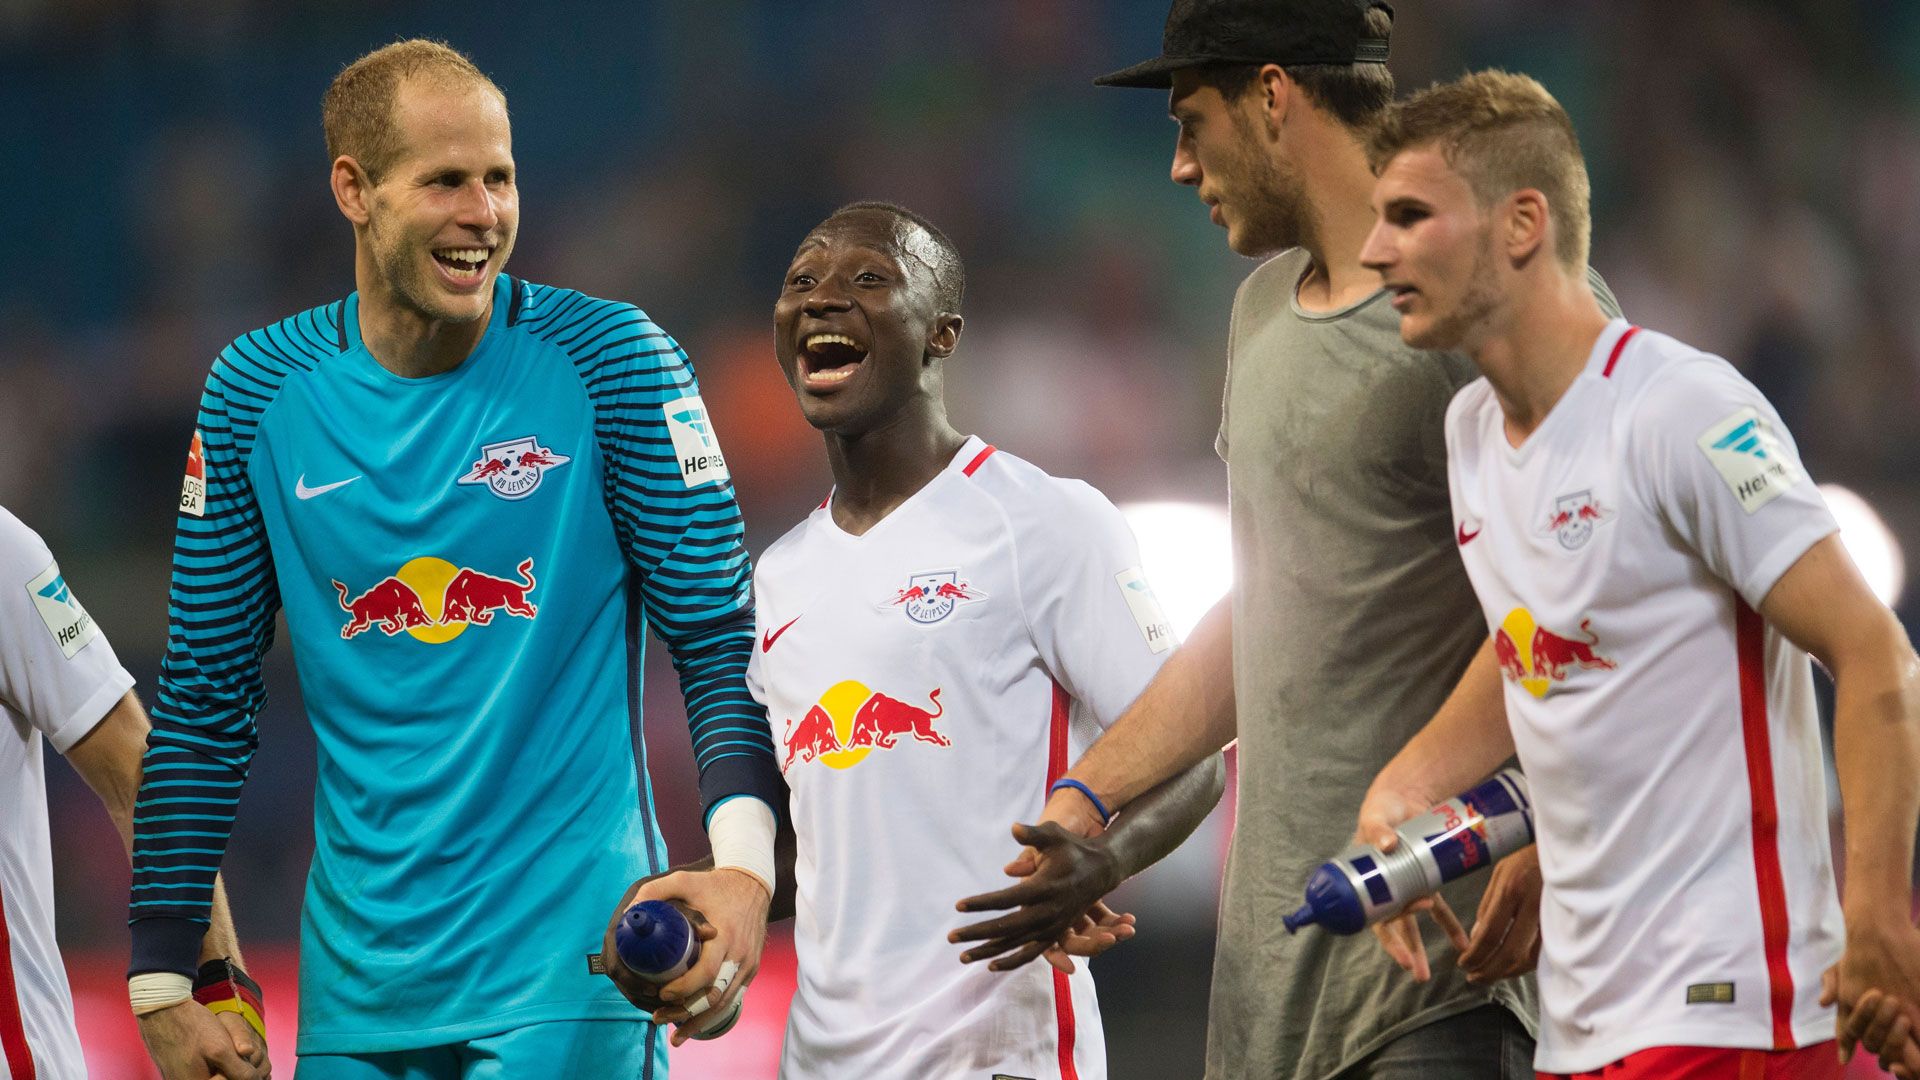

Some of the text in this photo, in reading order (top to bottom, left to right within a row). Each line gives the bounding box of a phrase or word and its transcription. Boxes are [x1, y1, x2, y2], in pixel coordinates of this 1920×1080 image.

[495, 471, 537, 491] RB LEIPZIG
[920, 601, 950, 619] LEIPZIG
